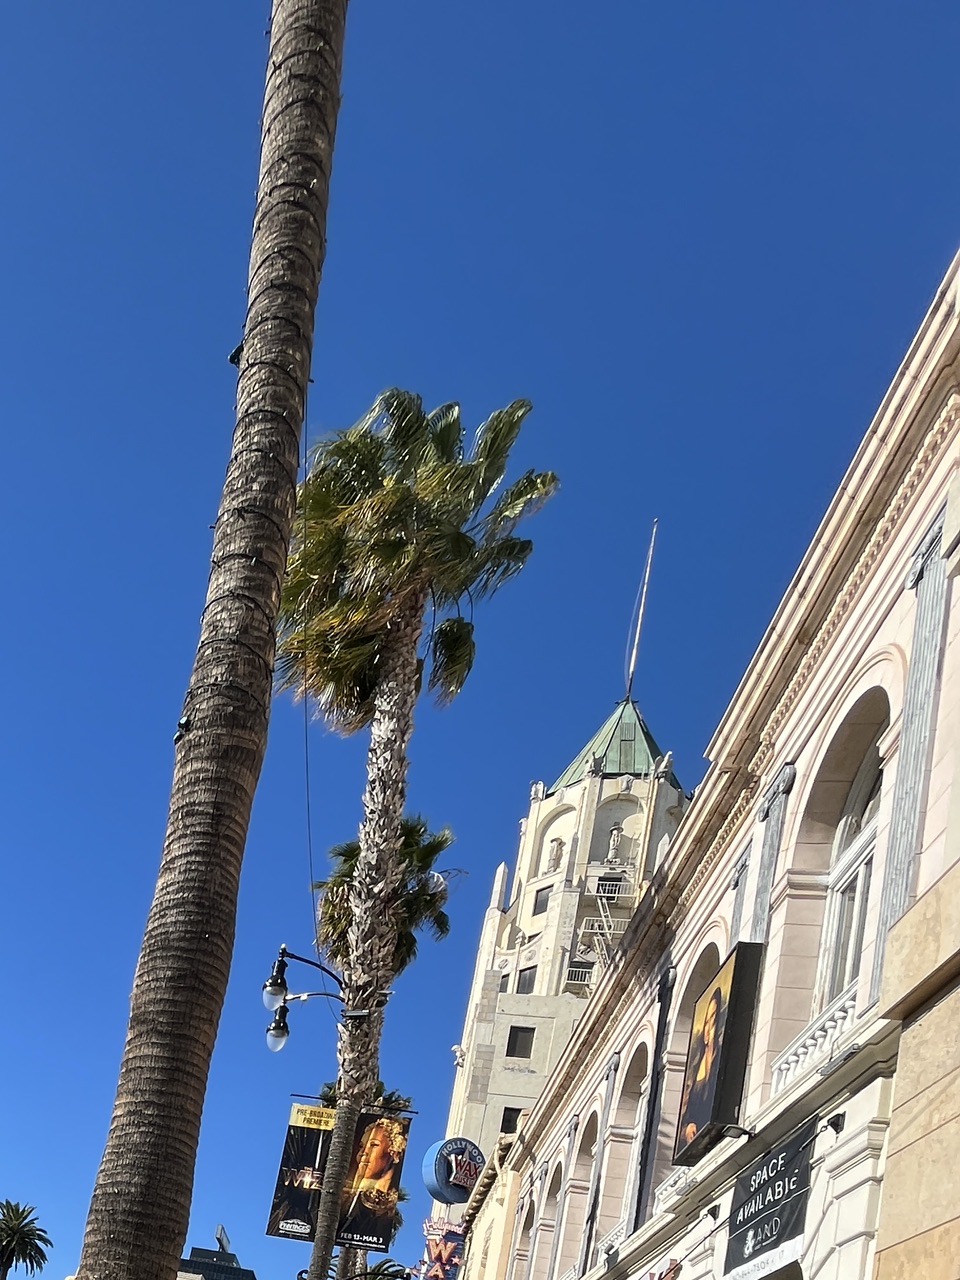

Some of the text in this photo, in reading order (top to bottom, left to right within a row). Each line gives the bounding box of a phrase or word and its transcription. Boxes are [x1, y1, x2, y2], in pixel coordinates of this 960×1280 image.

[302, 1117, 331, 1127] PREMIERE
[454, 1154, 481, 1179] WAX
[750, 1152, 786, 1192] SPACE
